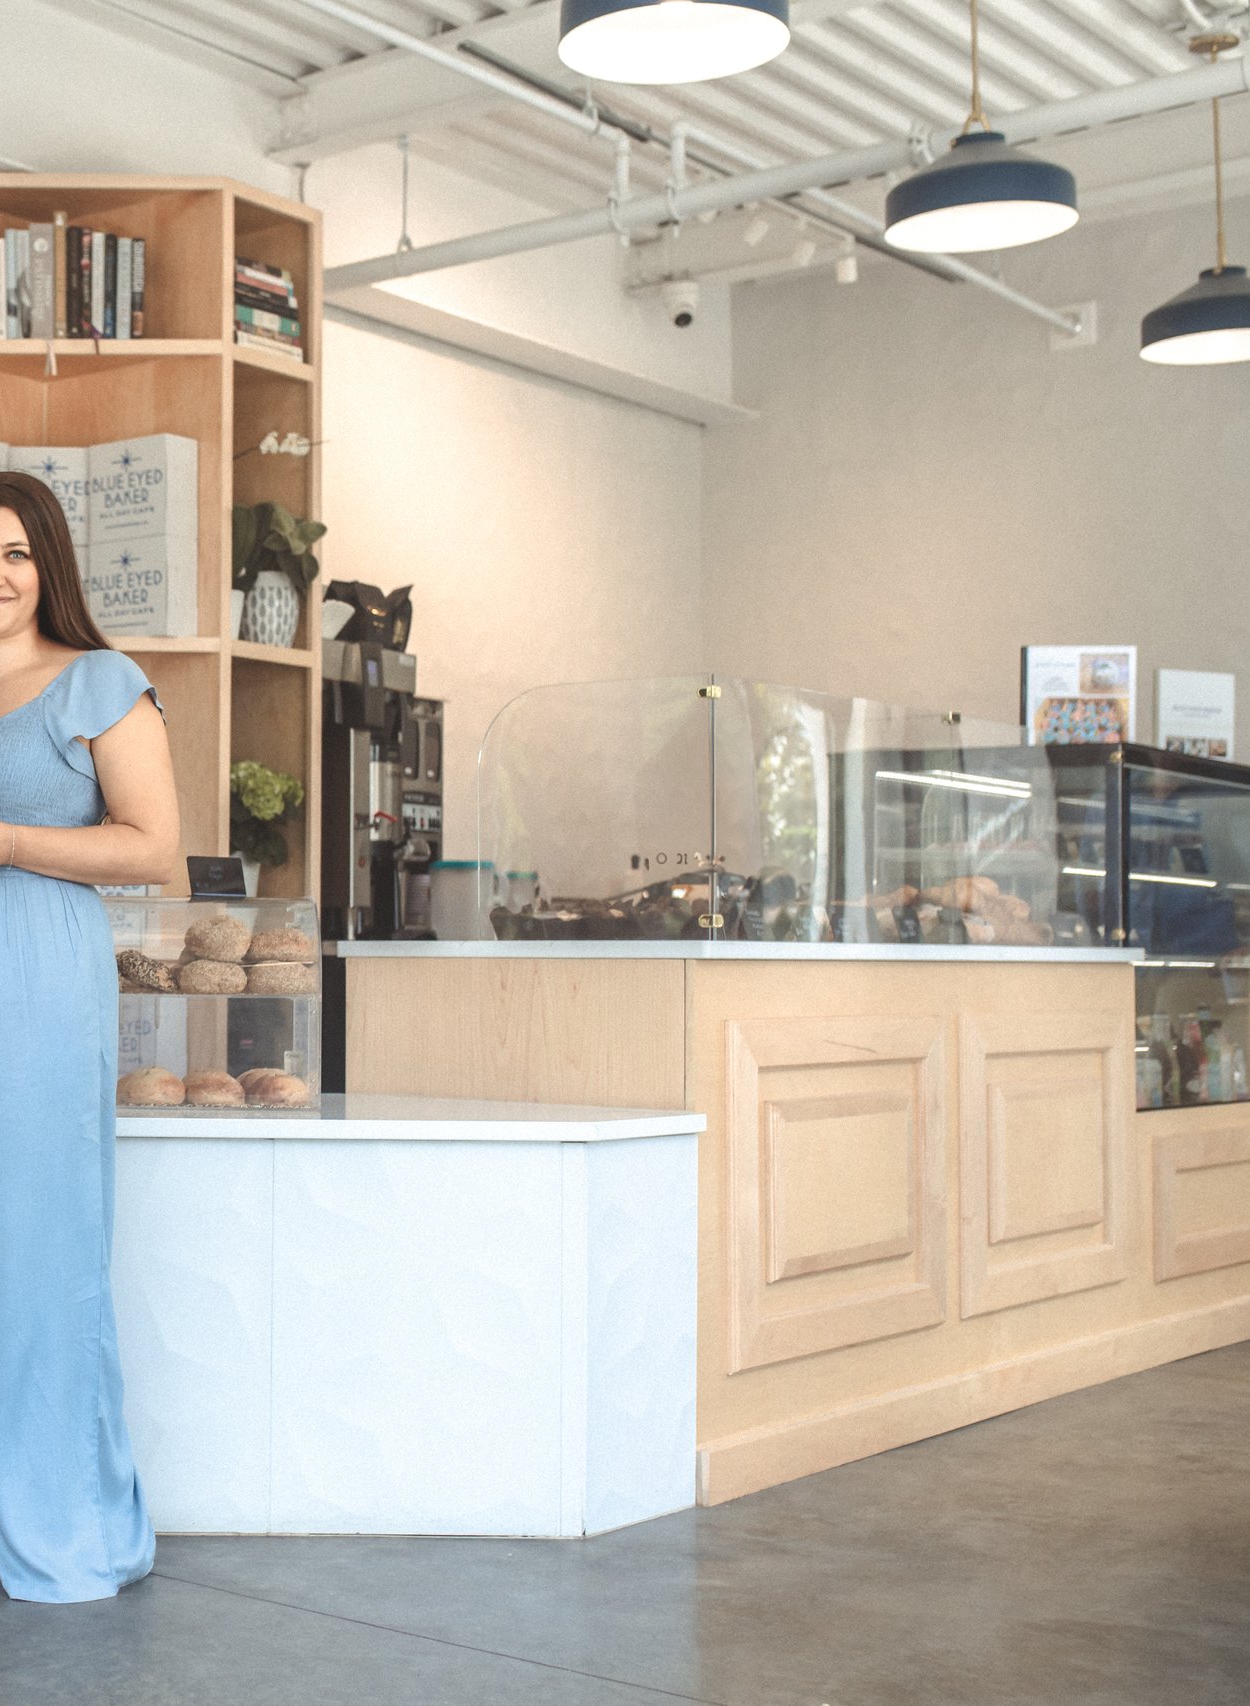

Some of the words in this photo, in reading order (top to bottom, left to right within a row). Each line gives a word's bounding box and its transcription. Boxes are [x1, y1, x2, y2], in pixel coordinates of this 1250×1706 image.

[92, 473, 124, 493] BLUE
[128, 469, 163, 488] EYED
[104, 488, 149, 509] BAKER
[91, 573, 122, 592] BLUE
[127, 570, 163, 588] EYED
[103, 589, 148, 608] BAKER
